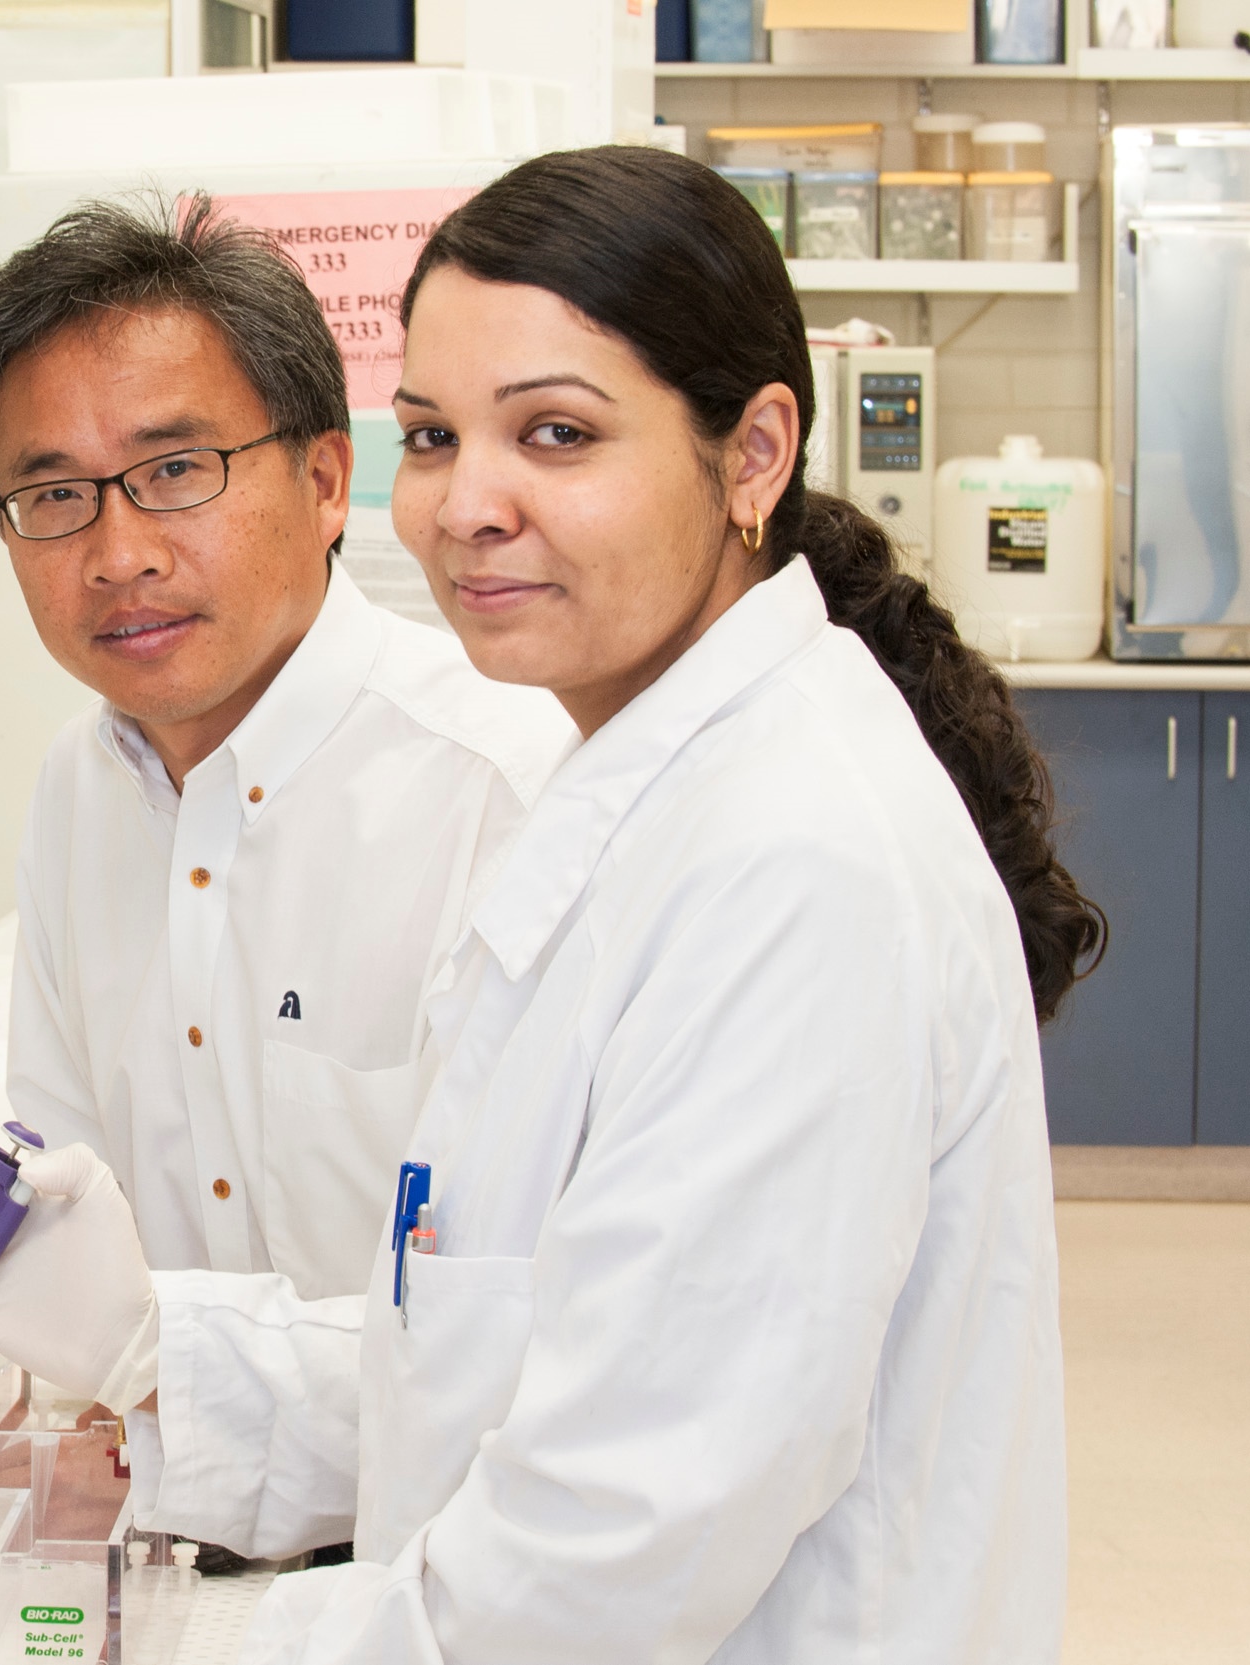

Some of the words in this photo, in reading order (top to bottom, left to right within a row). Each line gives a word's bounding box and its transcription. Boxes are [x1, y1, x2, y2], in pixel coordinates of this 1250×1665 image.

[278, 223, 398, 244] MERGENCY
[309, 253, 347, 273] 333
[358, 294, 401, 311] PHO
[25, 1609, 80, 1621] BIO-RAD
[25, 1646, 63, 1657] Model
[67, 1648, 84, 1658] 96
